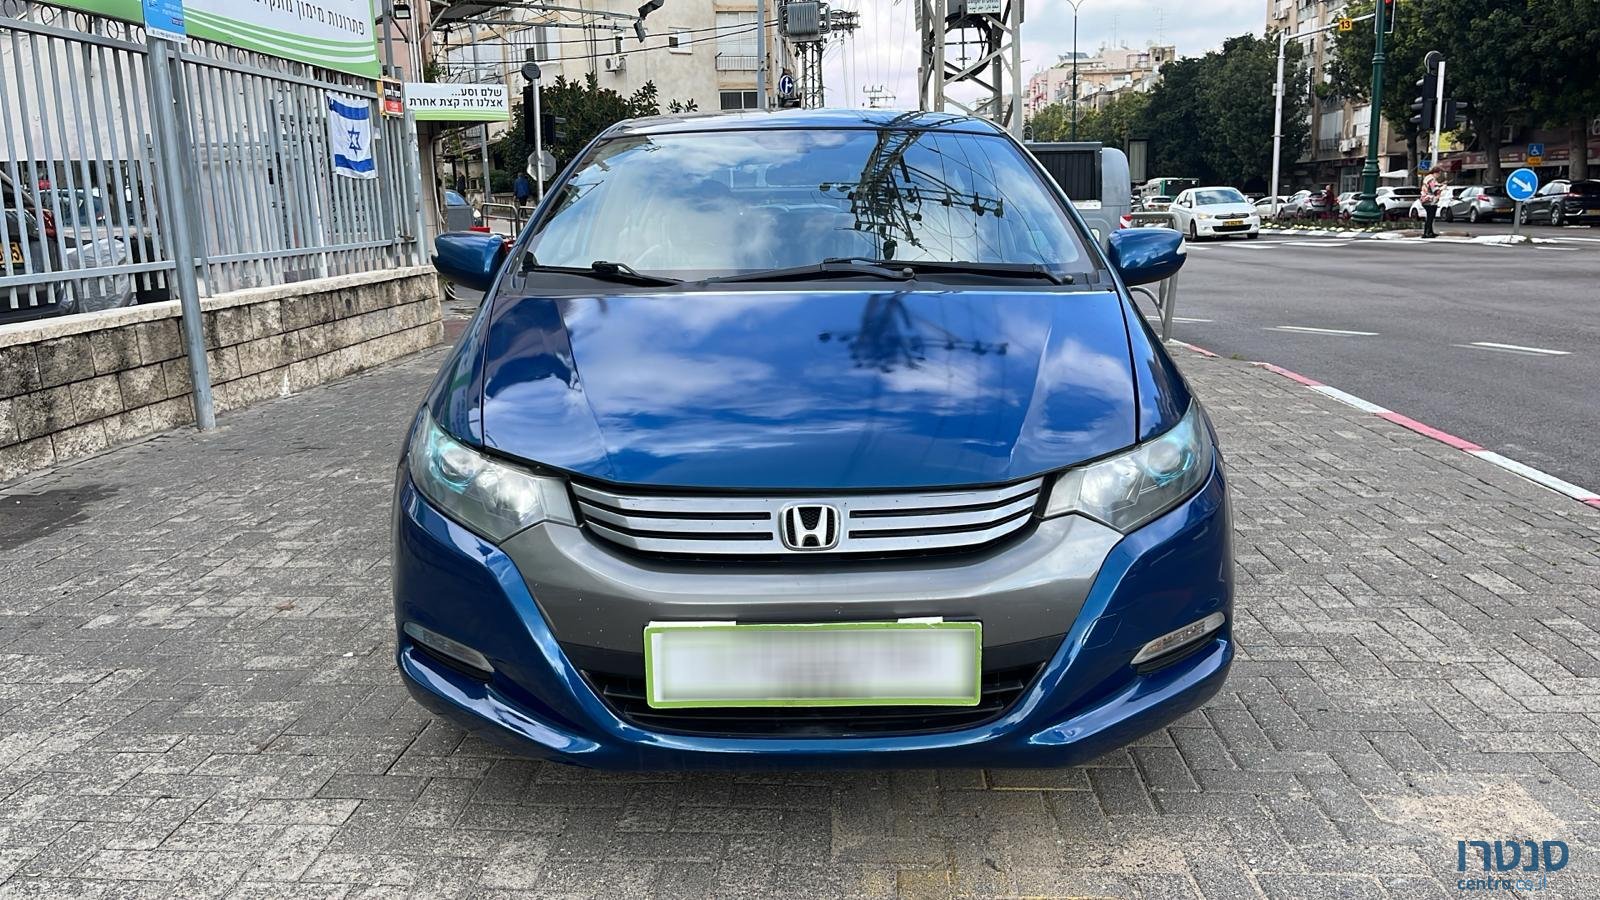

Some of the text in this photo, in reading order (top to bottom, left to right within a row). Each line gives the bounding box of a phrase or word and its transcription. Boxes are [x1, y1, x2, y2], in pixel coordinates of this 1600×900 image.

[297, 1, 325, 23] מימון
[328, 11, 365, 35] פתרונות
[1341, 21, 1350, 29] 13
[451, 87, 502, 97] שלם וסע...
[409, 98, 437, 107] אחרת
[439, 98, 460, 109] קצת
[463, 98, 474, 107] זה
[477, 97, 503, 107] אצלנו
